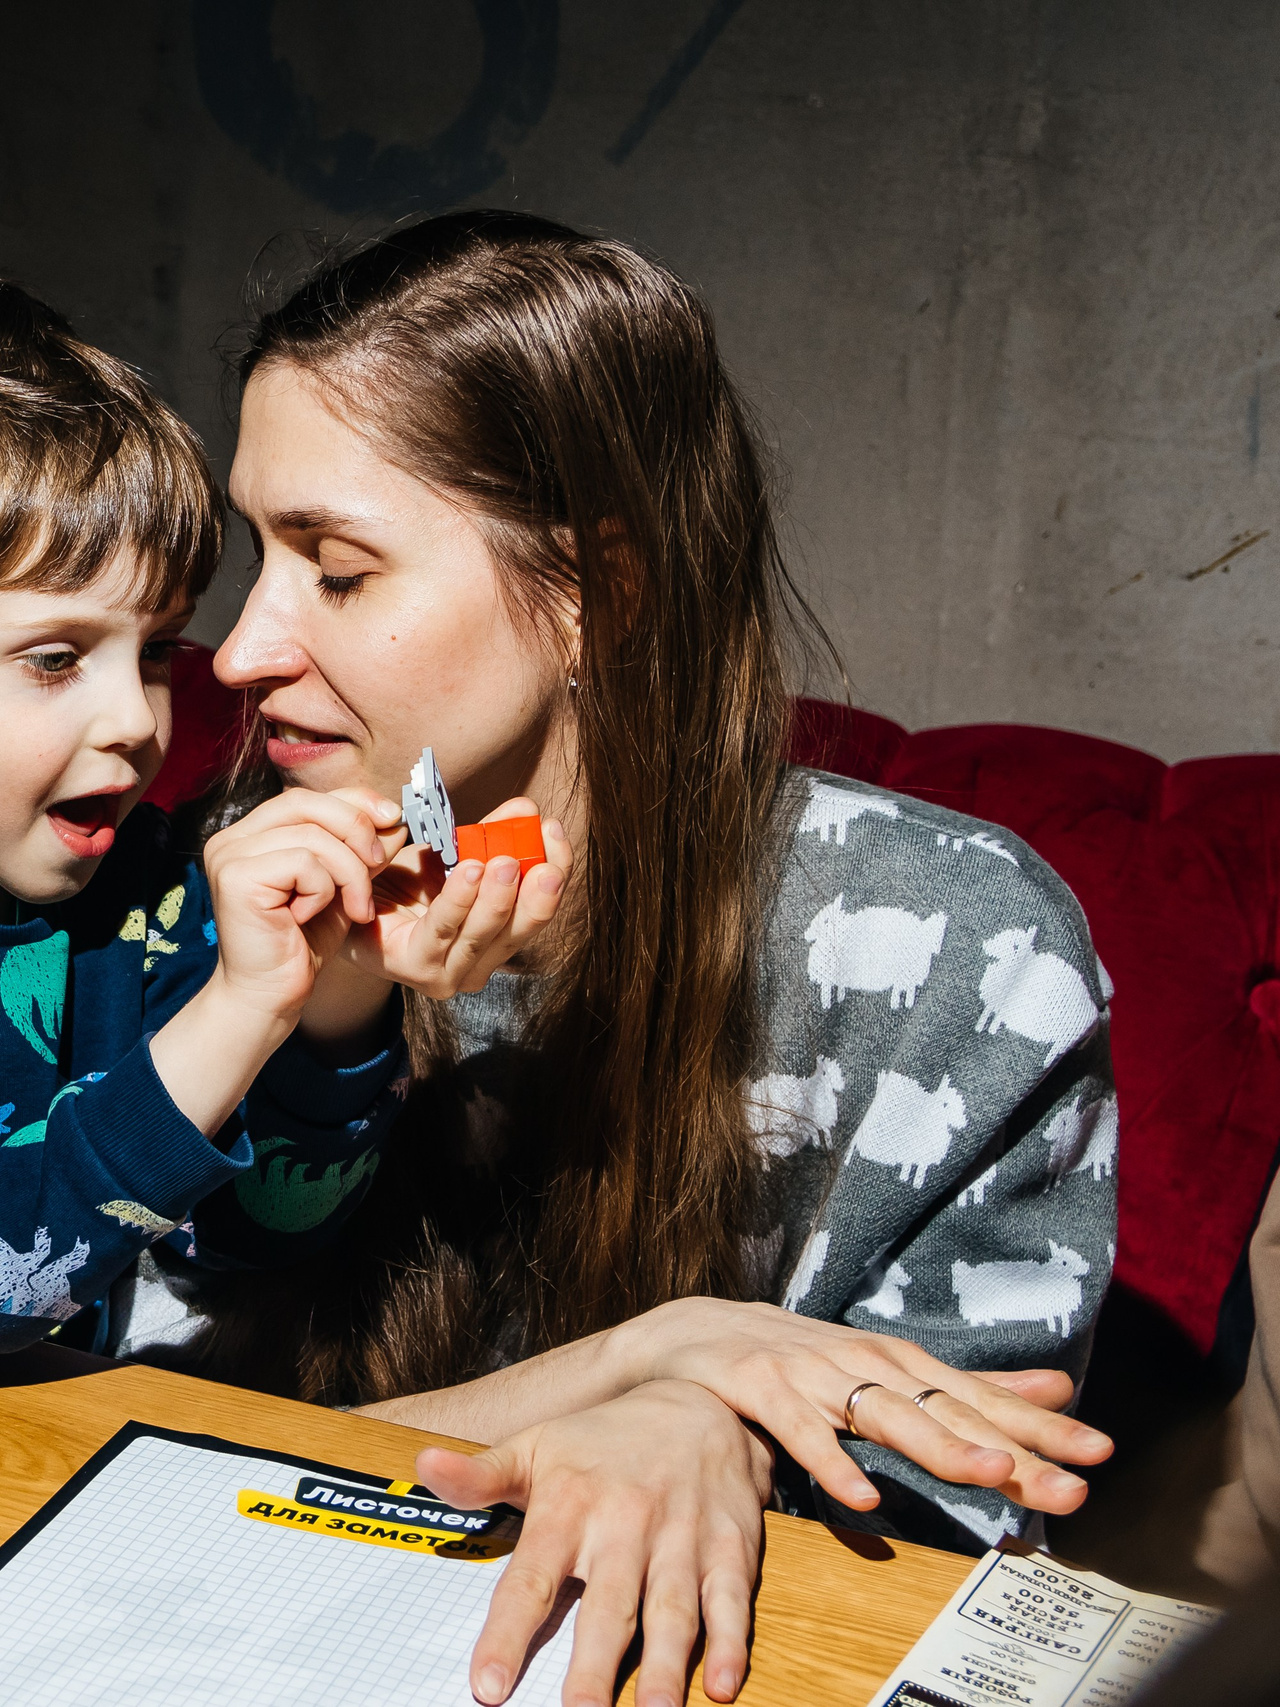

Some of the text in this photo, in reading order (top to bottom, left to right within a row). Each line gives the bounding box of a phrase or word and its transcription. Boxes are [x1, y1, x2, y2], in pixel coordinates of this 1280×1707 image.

[302, 1486, 490, 1529] Листочек
[247, 1501, 495, 1557] для заметок
[1002, 1592, 1085, 1629] КРАСНАЯ
[1008, 1604, 1068, 1632] БЕЛАЯ
[972, 1607, 1081, 1654] САНГРИЯ
[941, 1667, 1033, 1704] РОЗОВЫЕ
[965, 1668, 1020, 1691] ВИНА
